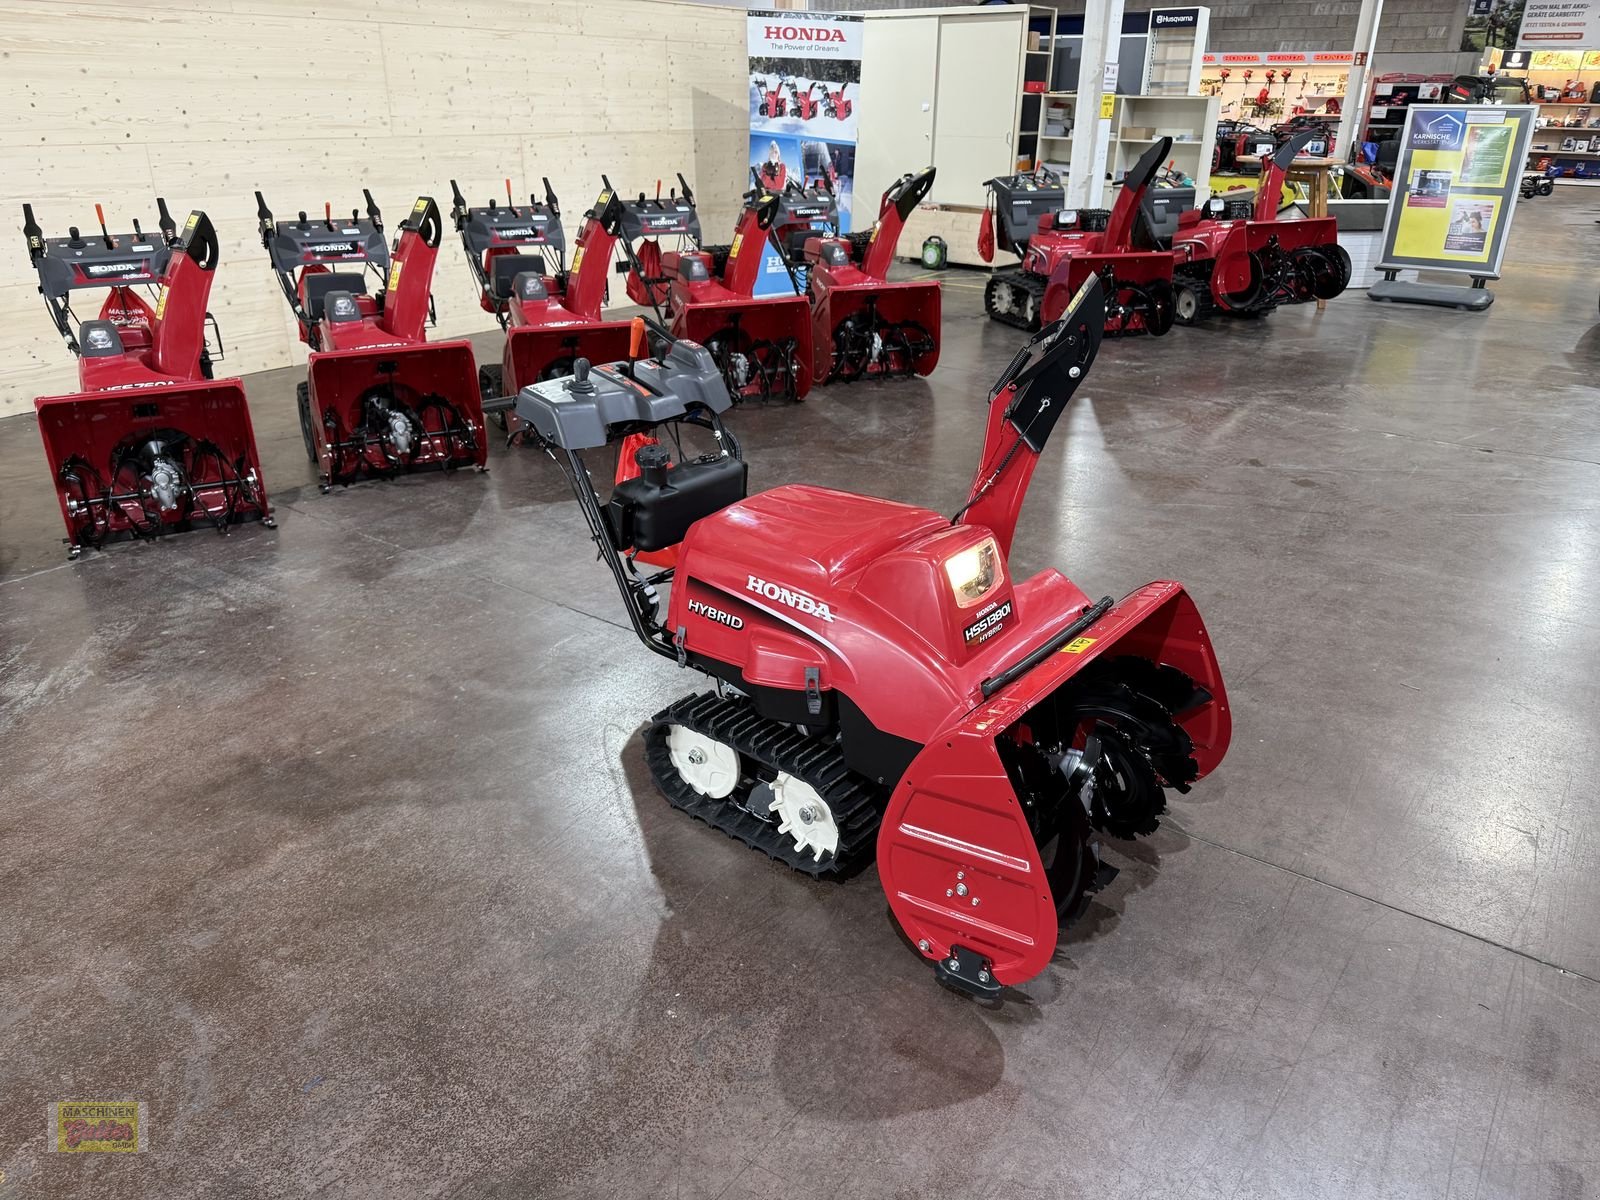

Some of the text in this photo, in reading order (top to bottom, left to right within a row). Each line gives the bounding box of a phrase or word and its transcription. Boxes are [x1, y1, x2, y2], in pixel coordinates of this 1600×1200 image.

[1162, 15, 1194, 23] Husqvarna
[764, 26, 846, 42] HONDA
[806, 43, 814, 51] of
[1223, 54, 1260, 62] HONDA
[1267, 54, 1306, 62] HONDA
[1313, 53, 1353, 61] HONDA
[315, 243, 353, 252] HONDA
[88, 263, 136, 273] HONDA
[746, 575, 835, 623] HONDA
[688, 599, 744, 629] HYBRID
[976, 601, 998, 619] HONDA
[965, 603, 1011, 641] HSS1380i
[979, 623, 1003, 644] HYBRID
